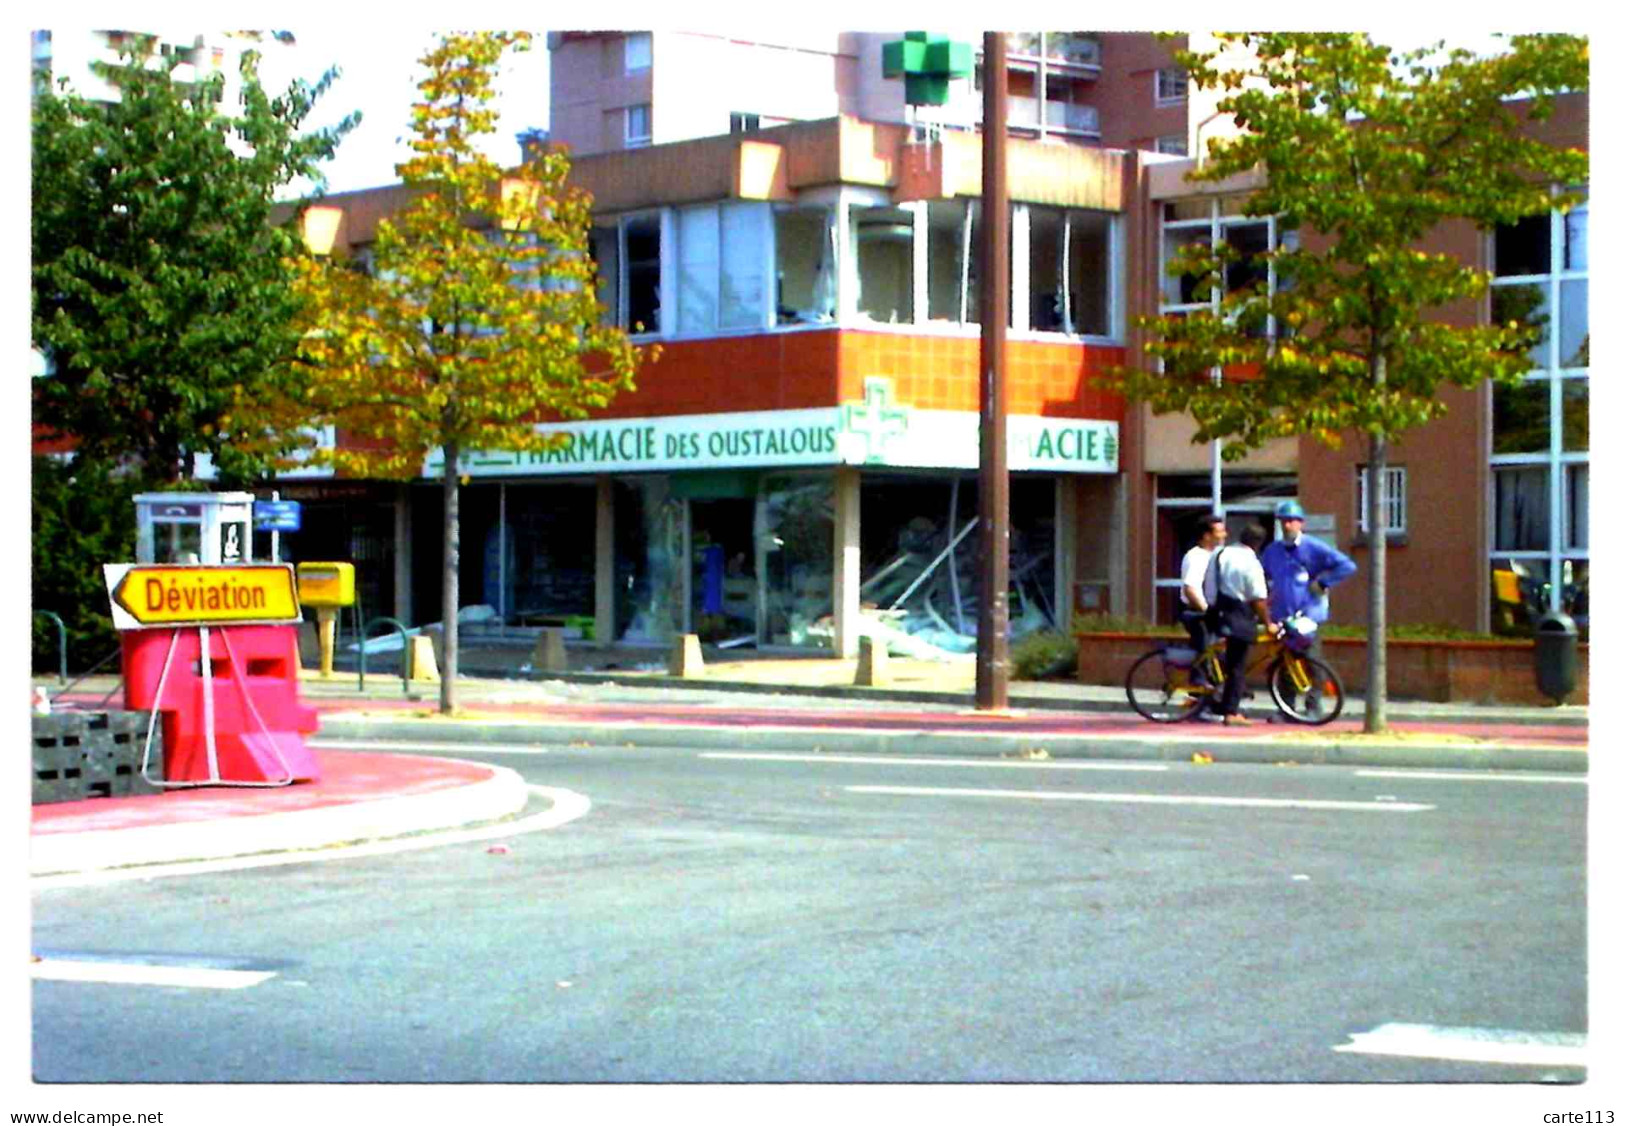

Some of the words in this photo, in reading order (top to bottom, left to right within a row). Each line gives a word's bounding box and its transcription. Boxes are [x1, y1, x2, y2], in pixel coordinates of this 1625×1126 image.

[666, 432, 700, 459] DES
[708, 426, 836, 458] OUSTALOUS
[145, 577, 266, 612] Déviation
